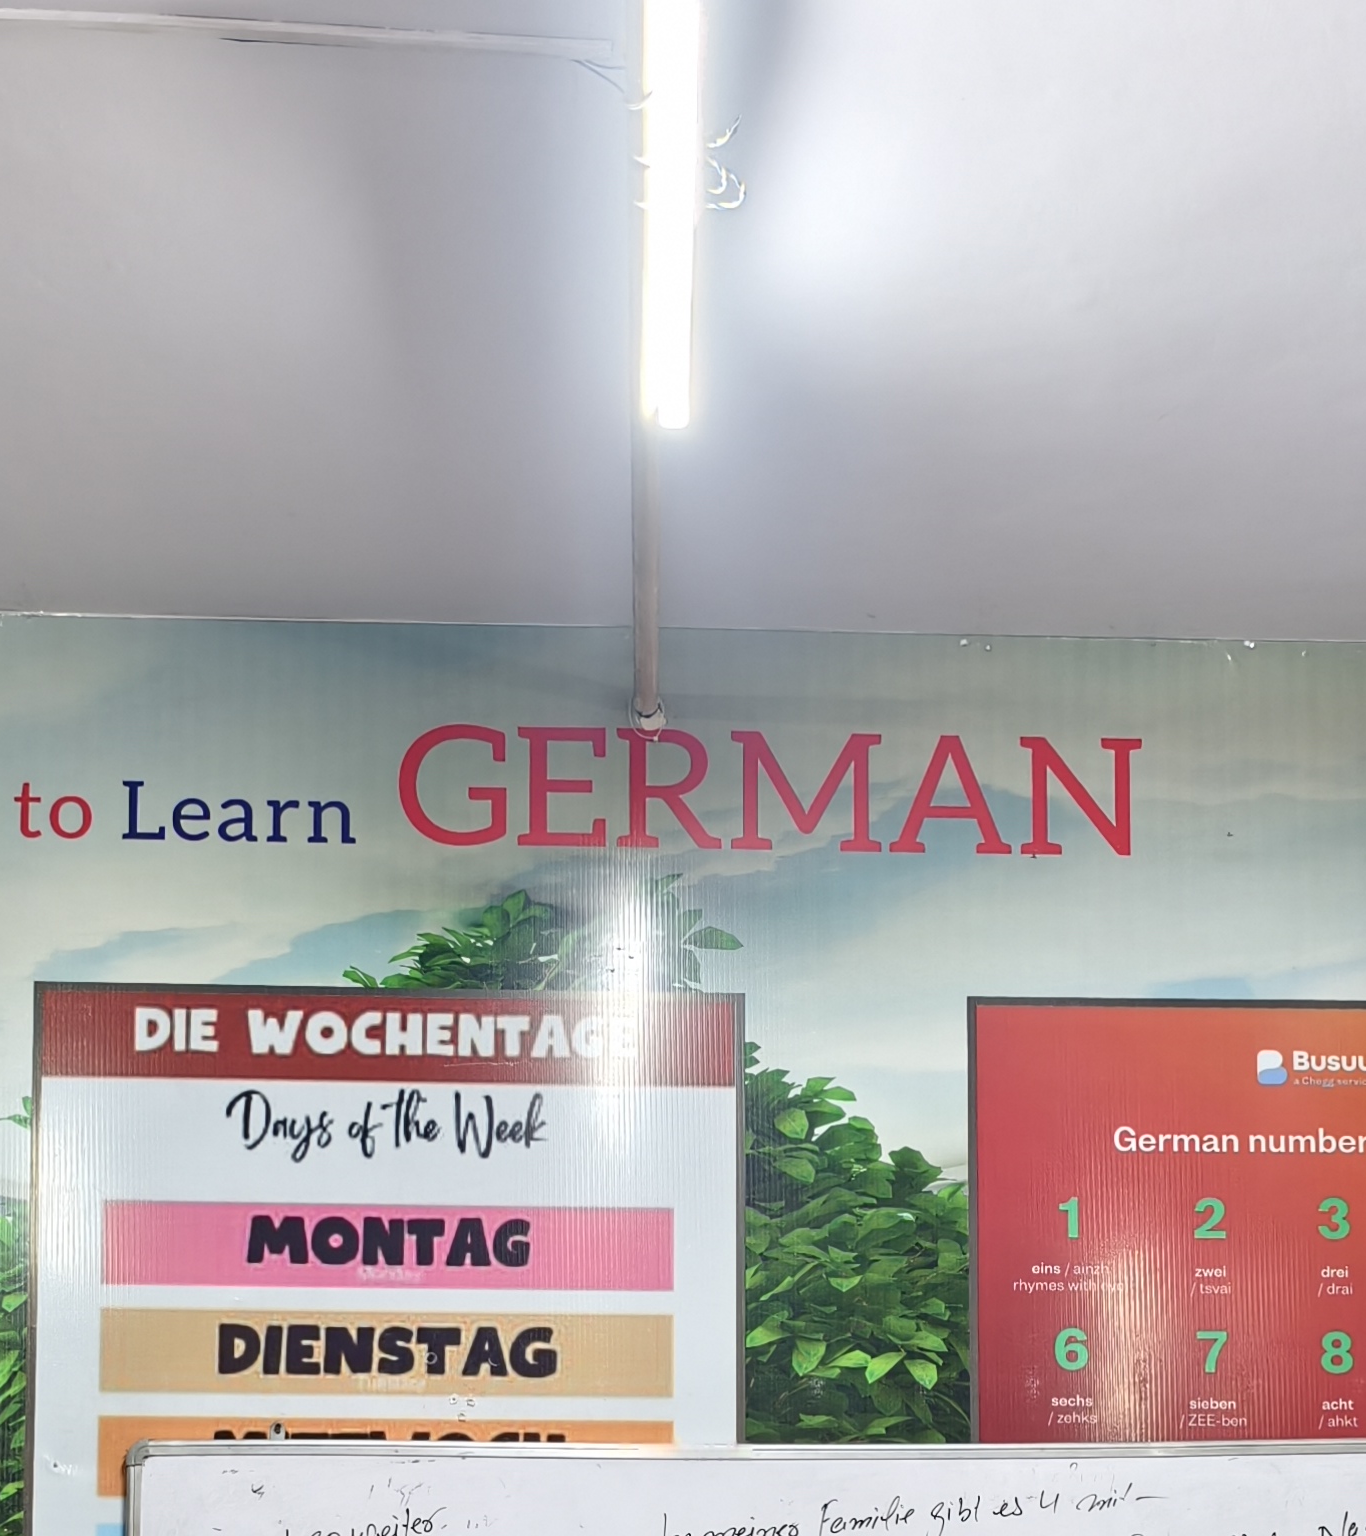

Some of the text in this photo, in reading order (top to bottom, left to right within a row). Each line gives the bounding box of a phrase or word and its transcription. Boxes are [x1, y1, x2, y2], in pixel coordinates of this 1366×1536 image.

[14, 782, 93, 839] to
[121, 779, 358, 847] Learn
[398, 723, 1145, 860] GERMAN
[134, 1006, 635, 1059] DIE WOCHENTAGE
[226, 1089, 548, 1162] Days of the Week
[1114, 1127, 1239, 1155] German
[247, 1215, 531, 1268] MONTAG
[1058, 1196, 1081, 1238] 1
[1193, 1196, 1227, 1239] 2
[1318, 1197, 1351, 1240] 3
[1032, 1263, 1061, 1275] eins
[1195, 1267, 1226, 1278] zwei
[1321, 1266, 1349, 1278] drei
[218, 1322, 558, 1378] DIENSTAG
[1054, 1328, 1089, 1371] 6
[1195, 1330, 1228, 1373] 7
[1320, 1331, 1354, 1374] 8
[1052, 1395, 1093, 1407] sechs
[1189, 1398, 1236, 1410] sieben
[1322, 1398, 1354, 1411] acht
